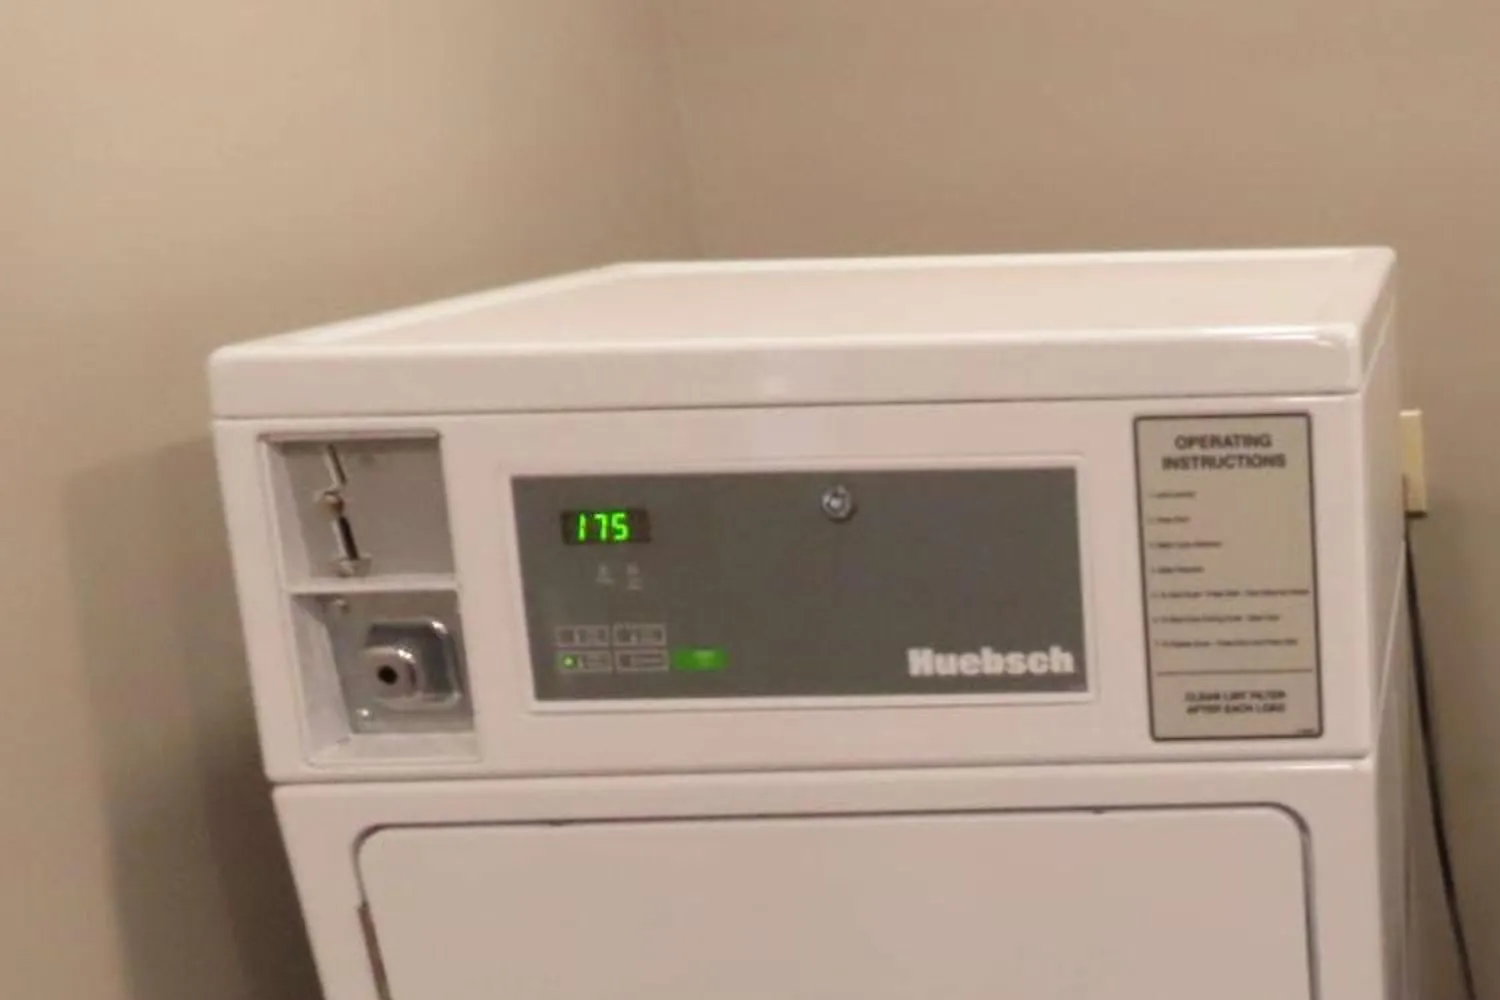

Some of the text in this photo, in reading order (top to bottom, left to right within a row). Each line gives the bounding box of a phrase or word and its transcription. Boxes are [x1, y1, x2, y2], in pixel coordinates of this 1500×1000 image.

[1174, 433, 1272, 450] OPERATING
[1161, 453, 1287, 471] INSTRUCTIONS
[907, 646, 1075, 677] Huebsch
